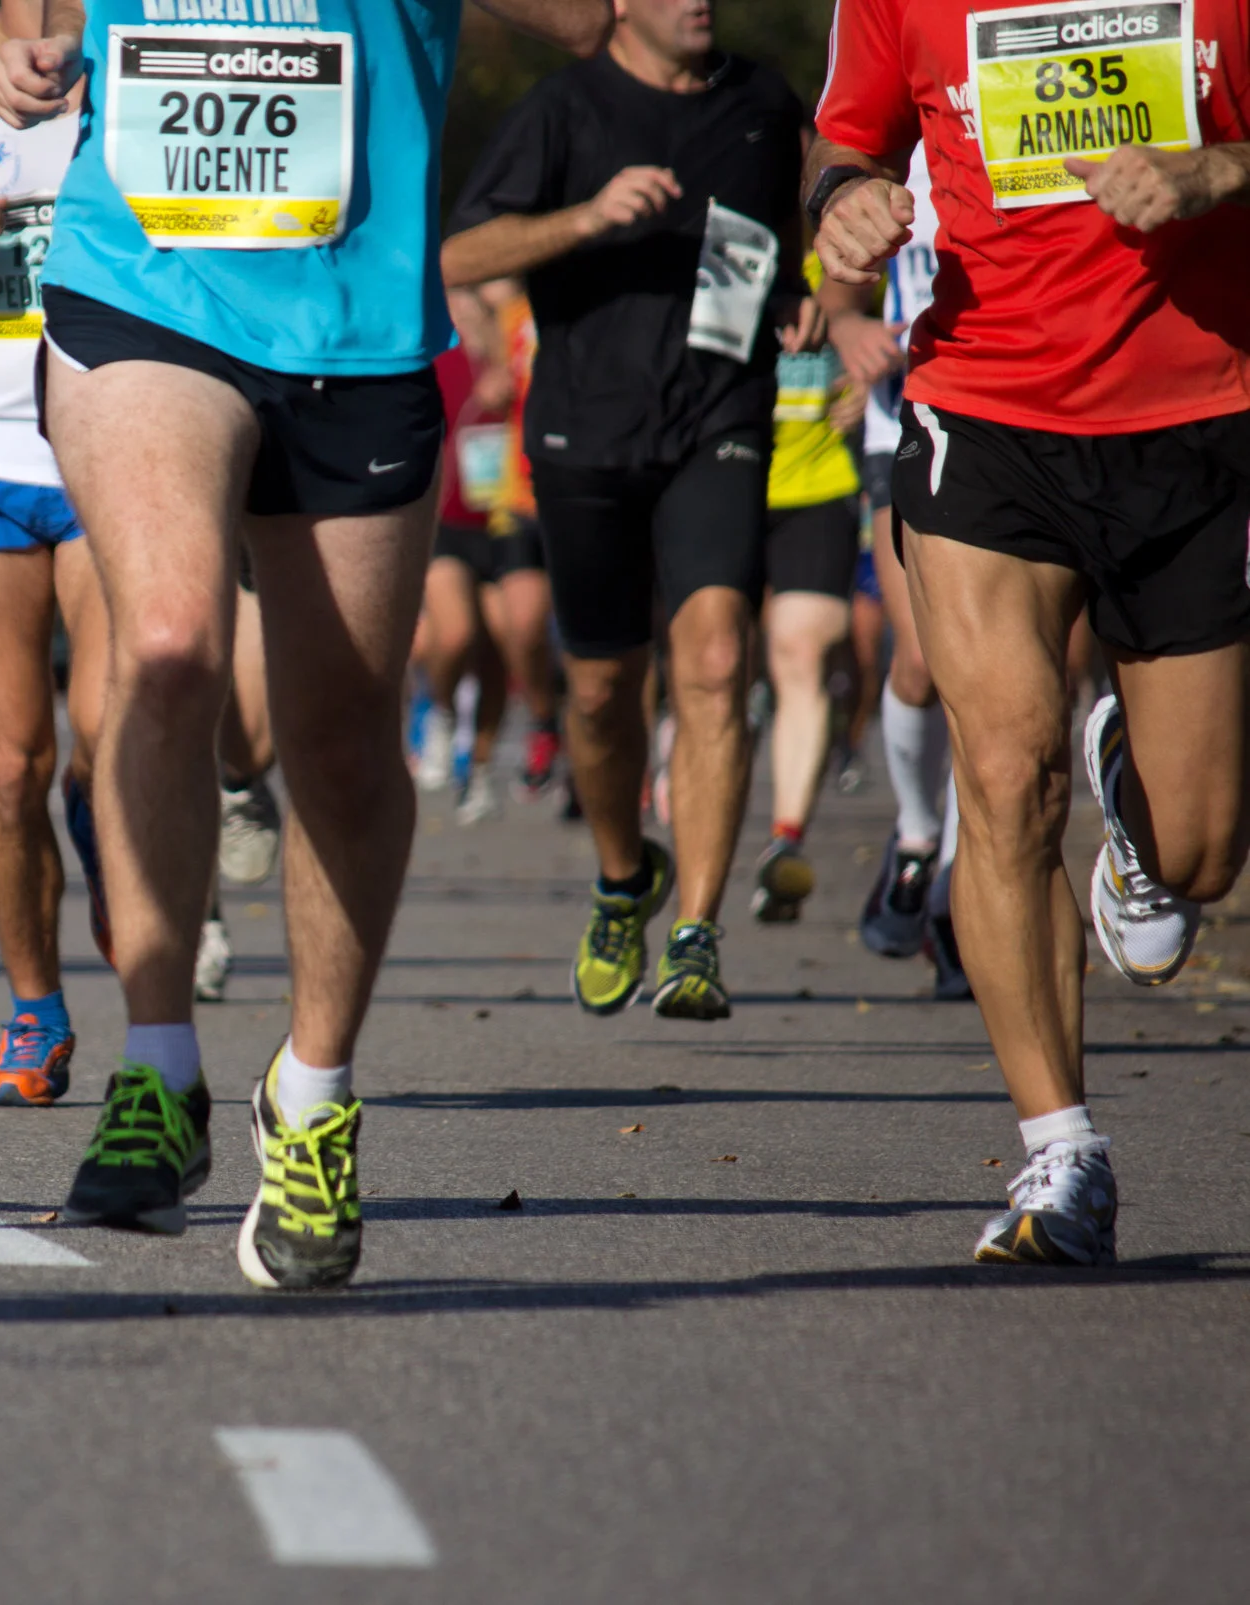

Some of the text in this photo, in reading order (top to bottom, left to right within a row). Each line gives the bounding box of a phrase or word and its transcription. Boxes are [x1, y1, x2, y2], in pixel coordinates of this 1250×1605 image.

[1060, 11, 1160, 45] adidas
[208, 47, 320, 78] adidas
[1034, 54, 1128, 103] 835
[158, 90, 298, 138] 2076
[1017, 101, 1153, 156] ARMANDO
[163, 145, 289, 193] VICENTE
